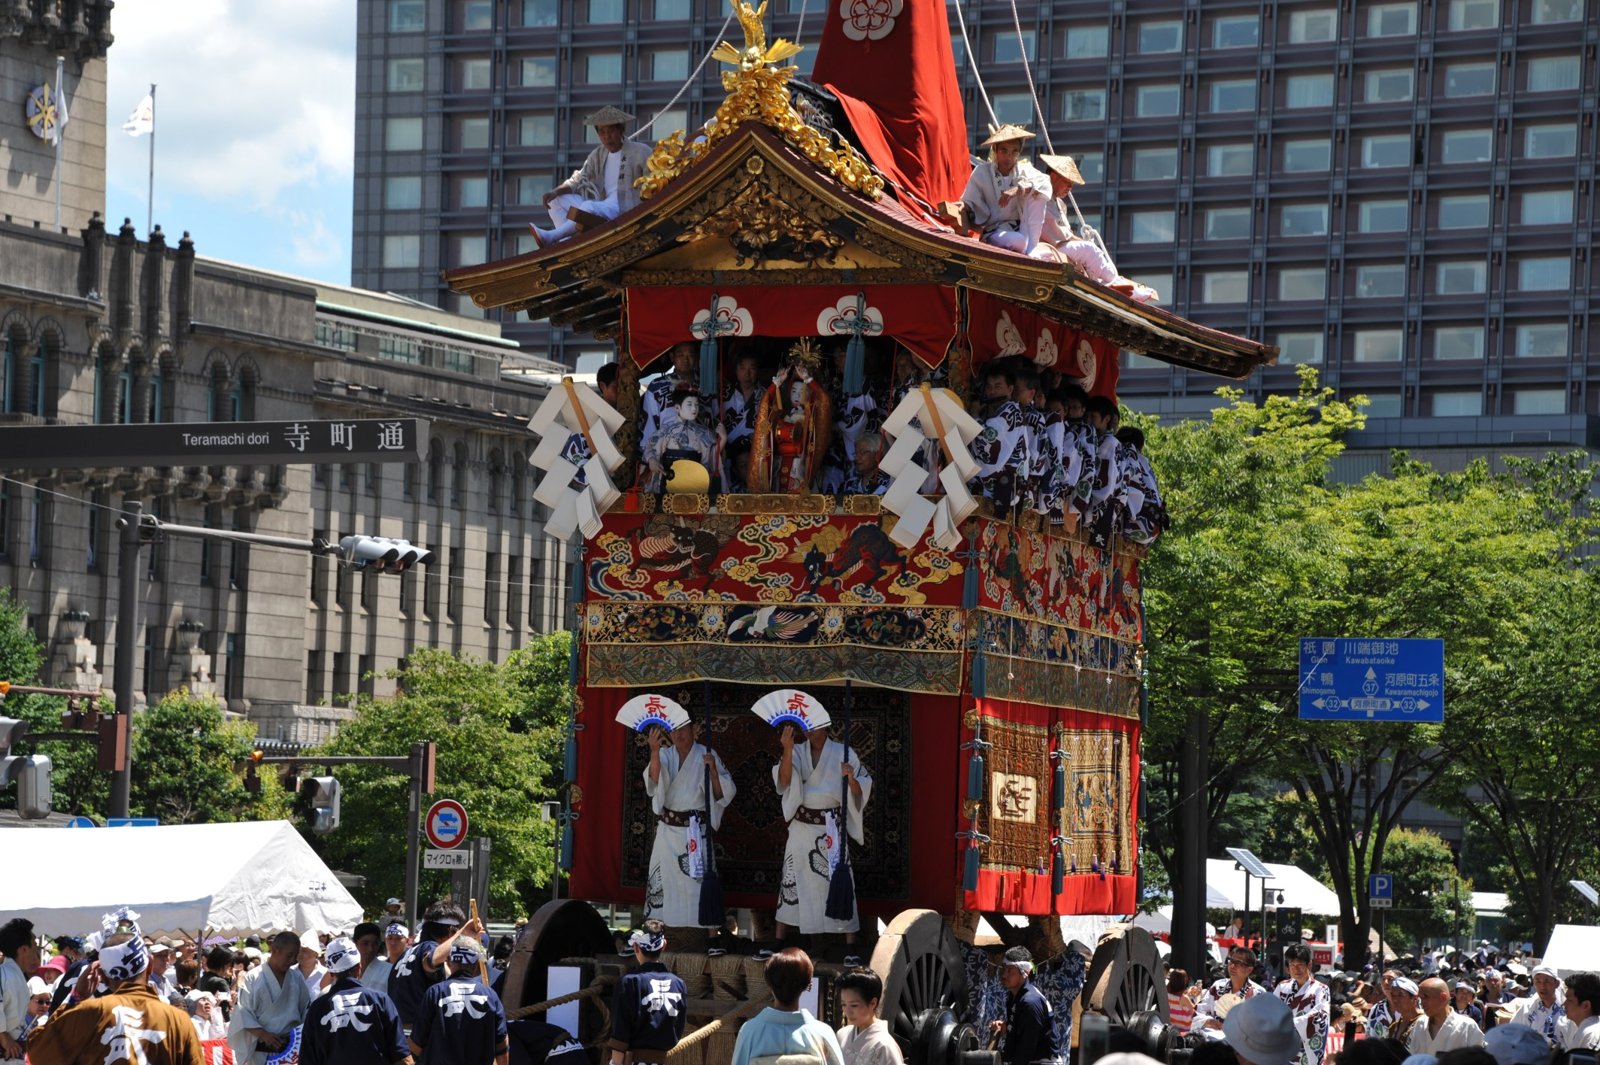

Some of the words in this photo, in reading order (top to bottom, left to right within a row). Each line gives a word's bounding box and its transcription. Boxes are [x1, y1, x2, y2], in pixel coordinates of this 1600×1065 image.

[182, 432, 245, 447] Teramachi
[246, 431, 270, 446] dori
[283, 421, 406, 452] 寺町通
[1343, 641, 1399, 656] 川端御池
[1310, 656, 1328, 664] Gion
[1345, 656, 1395, 664] Kawabataoike
[1303, 672, 1334, 686] 下鴨
[1385, 673, 1440, 687] 河原町五条
[1301, 687, 1335, 695] Shimogamo
[1365, 684, 1376, 692] 37
[1384, 688, 1438, 697] Kawaramachigojo
[1327, 700, 1338, 708] 32
[1403, 700, 1414, 709] 32
[426, 853, 467, 867] マイクロを除く
[438, 982, 489, 1020] 長
[641, 978, 682, 1017] 長
[320, 990, 375, 1033] 長
